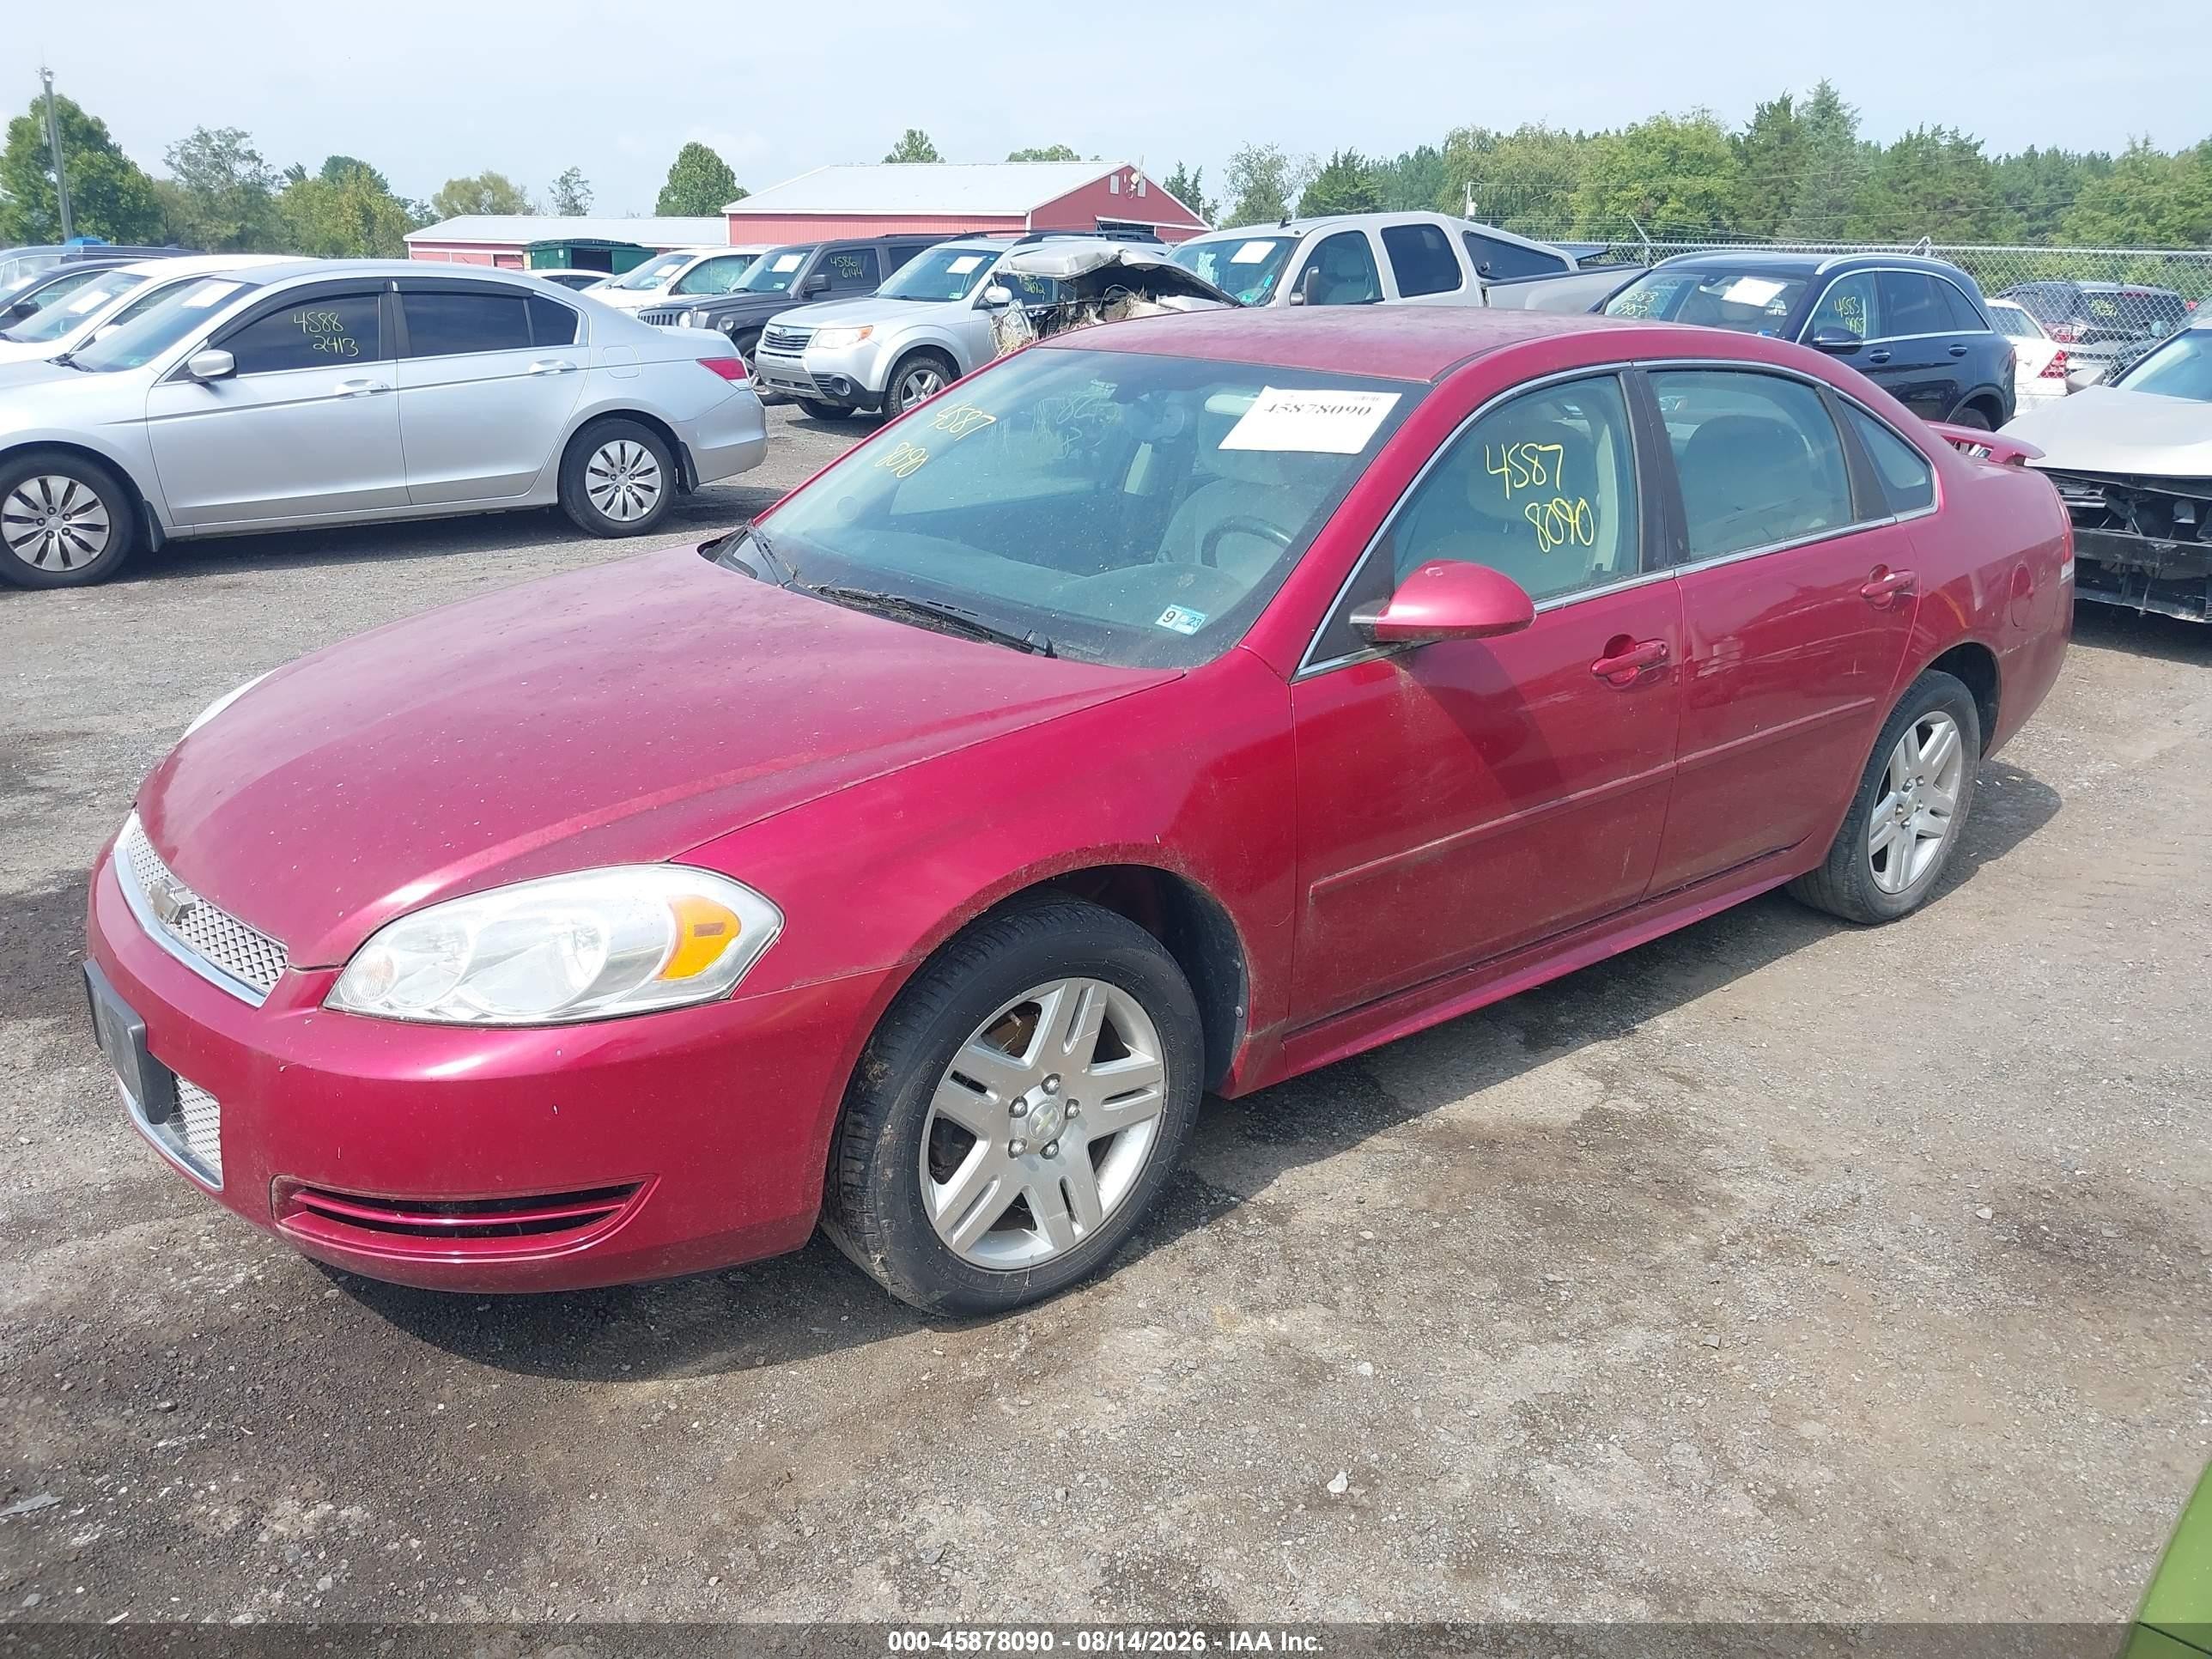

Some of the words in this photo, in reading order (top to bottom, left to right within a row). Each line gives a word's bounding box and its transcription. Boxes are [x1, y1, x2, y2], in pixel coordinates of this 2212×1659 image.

[830, 255, 858, 268] 4586
[842, 267, 864, 279] 6144
[1833, 296, 1861, 319] 4583
[294, 312, 343, 334] 4588
[313, 336, 359, 357] 2413
[1263, 403, 1373, 417] 45878090
[927, 402, 997, 442] 4587
[874, 441, 930, 478] 8090
[1485, 441, 1564, 501] 4587
[1524, 496, 1595, 553] 8090
[1162, 611, 1176, 623] 9
